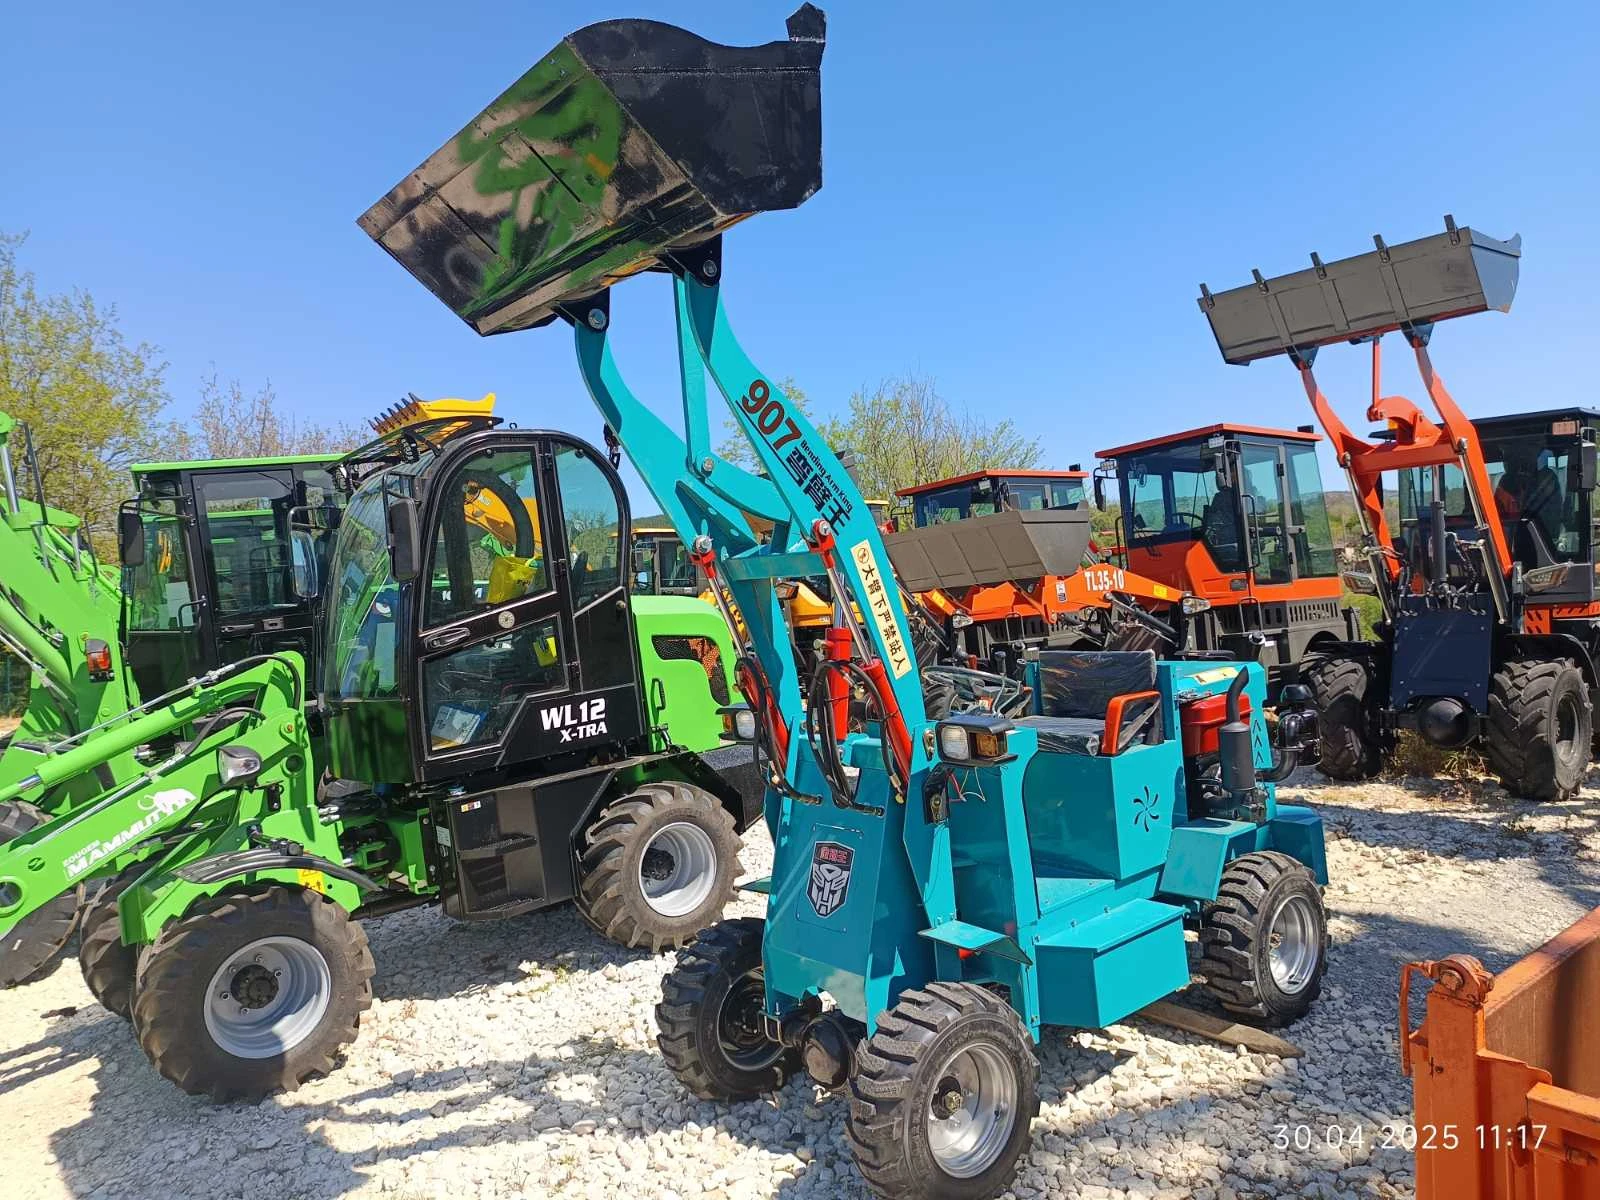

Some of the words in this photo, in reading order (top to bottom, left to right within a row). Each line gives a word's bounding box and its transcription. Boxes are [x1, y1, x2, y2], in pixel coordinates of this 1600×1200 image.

[741, 379, 803, 451] 907
[800, 439, 827, 478] Bending
[837, 487, 853, 514] King
[1084, 569, 1125, 592] TL35-10
[540, 697, 606, 731] WL12
[559, 721, 608, 744] X-TRA
[66, 808, 167, 878] MAMMUT
